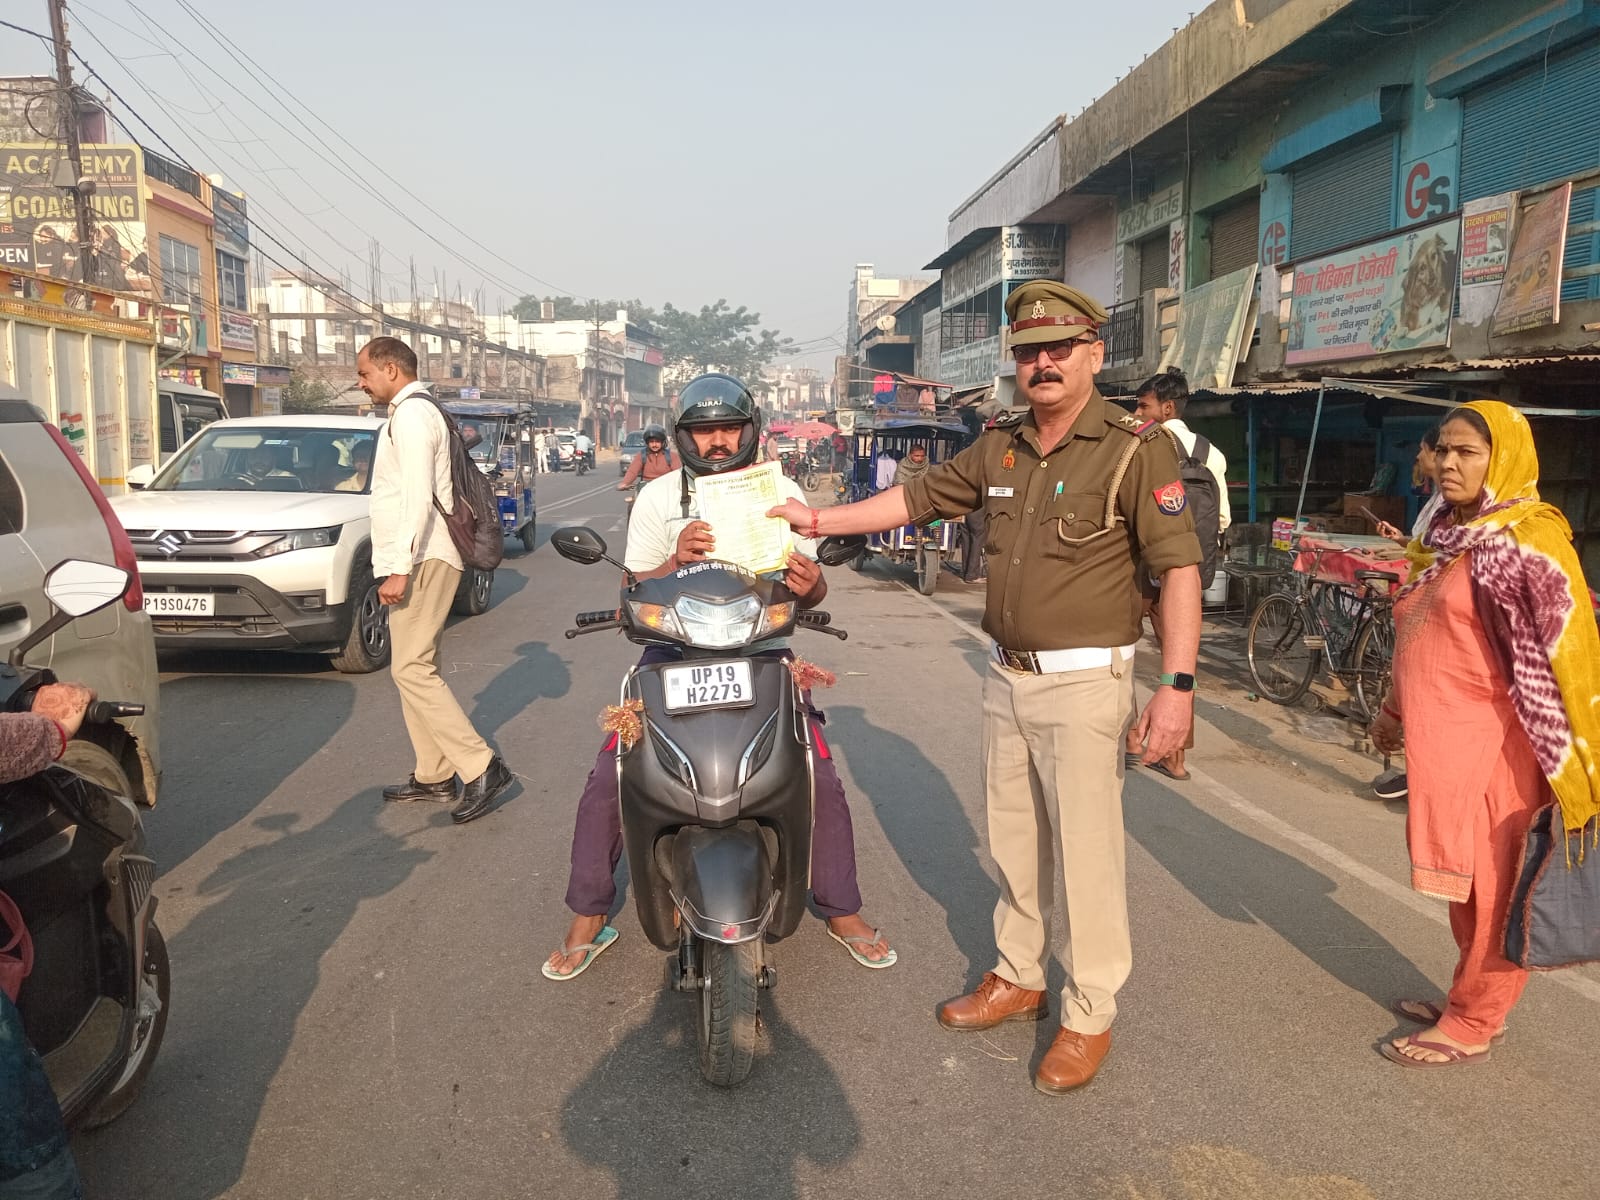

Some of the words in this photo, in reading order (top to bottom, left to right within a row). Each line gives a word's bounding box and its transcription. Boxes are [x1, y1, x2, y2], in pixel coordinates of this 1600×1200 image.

[6, 155, 131, 174] ACEMY
[13, 195, 135, 219] COACING
[696, 400, 723, 408] SURAJ
[691, 665, 735, 685] UP19
[687, 683, 742, 704] H2279
